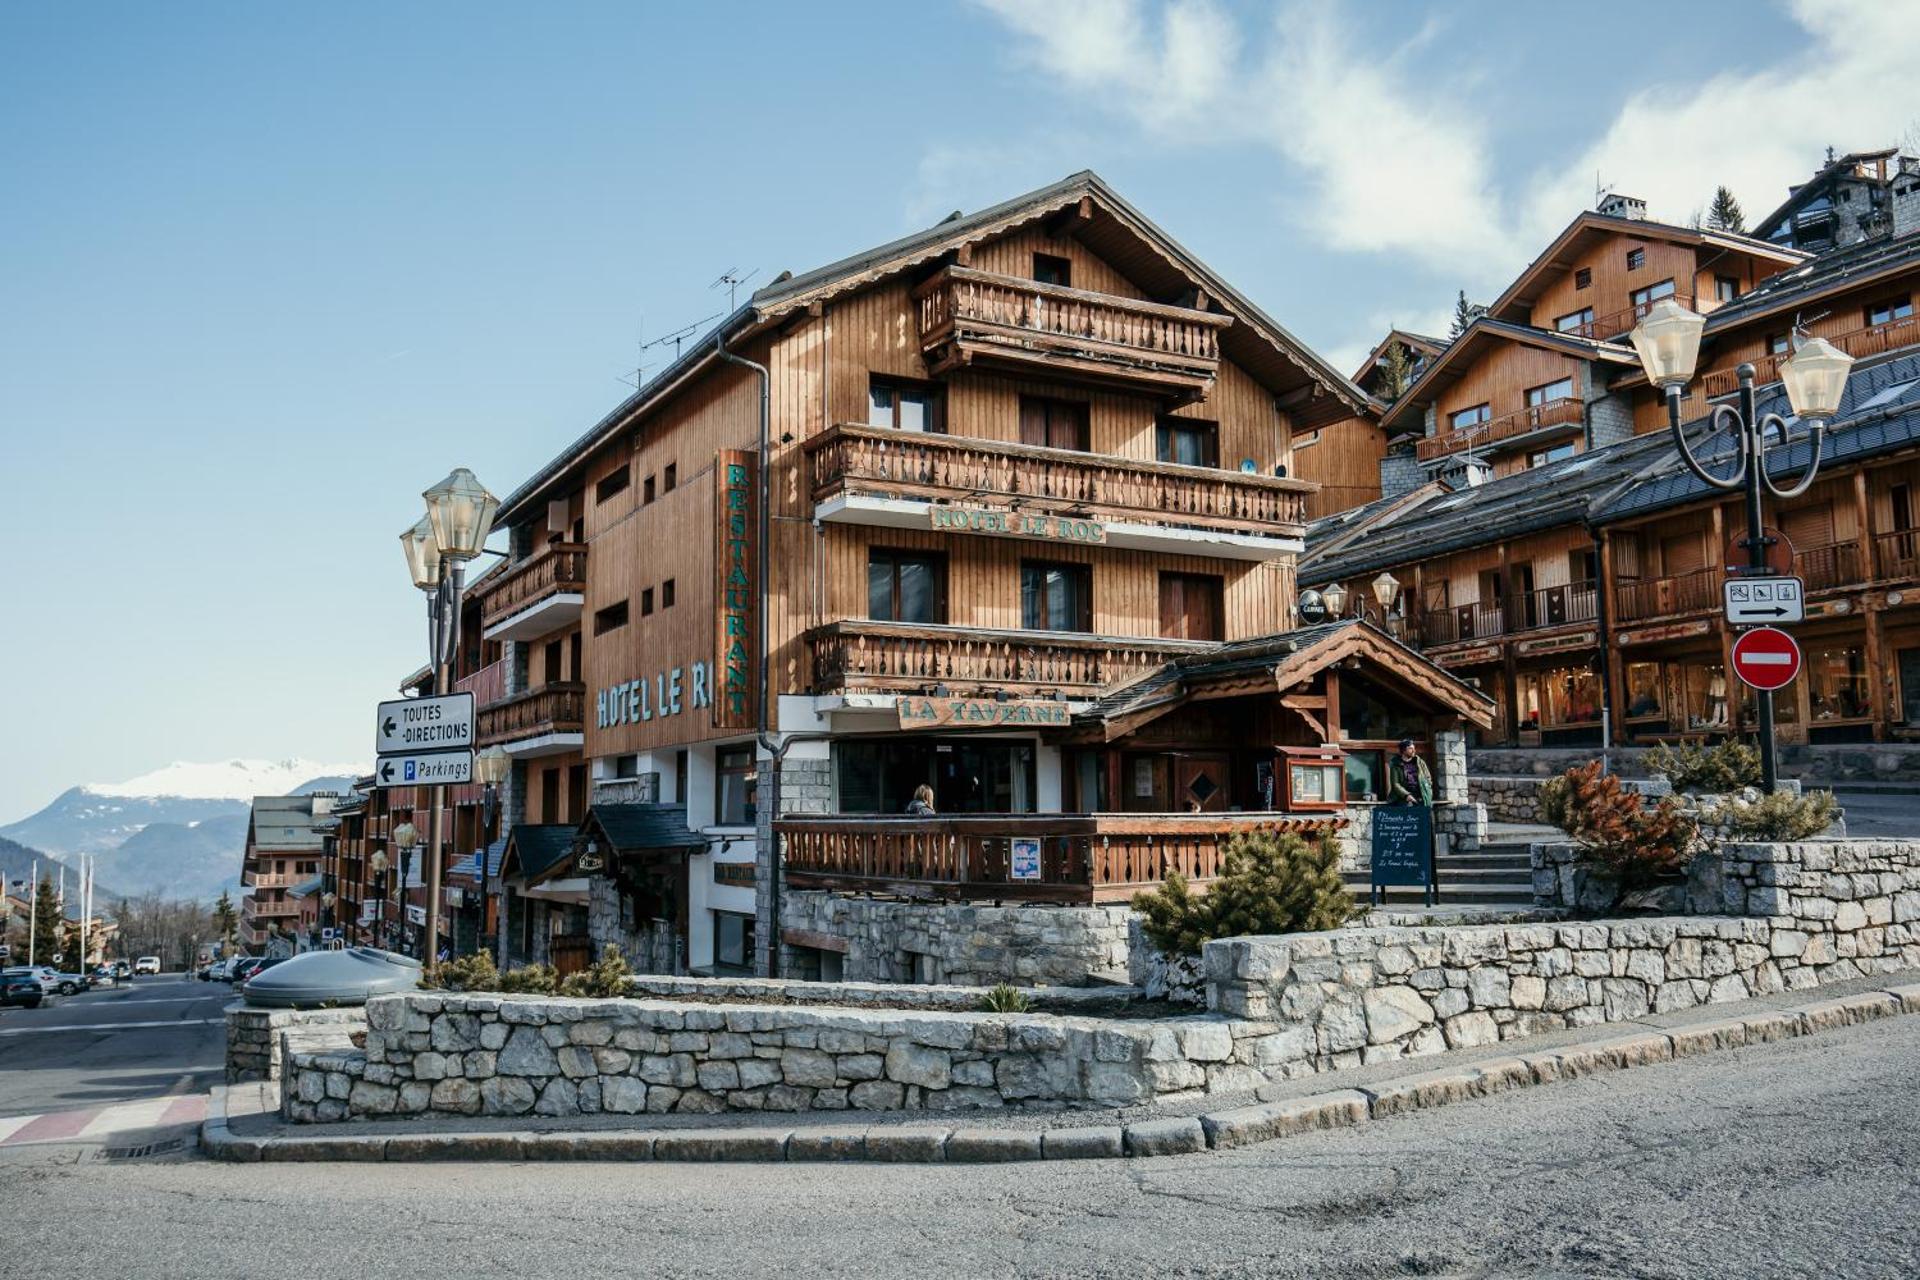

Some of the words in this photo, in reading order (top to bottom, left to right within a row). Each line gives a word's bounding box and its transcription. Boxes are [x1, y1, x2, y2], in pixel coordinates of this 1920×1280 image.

[934, 509, 1008, 532] HOTEL
[1022, 516, 1048, 537] LE
[1058, 520, 1104, 541] ROC
[726, 464, 750, 714] RESTAURANT
[597, 676, 652, 729] HOTEL
[657, 667, 683, 718] LE
[901, 699, 938, 720] LA
[950, 702, 1066, 723] TAVERNE
[403, 704, 441, 722] TOUTES
[405, 762, 414, 779] P
[418, 760, 468, 779] Parkings
